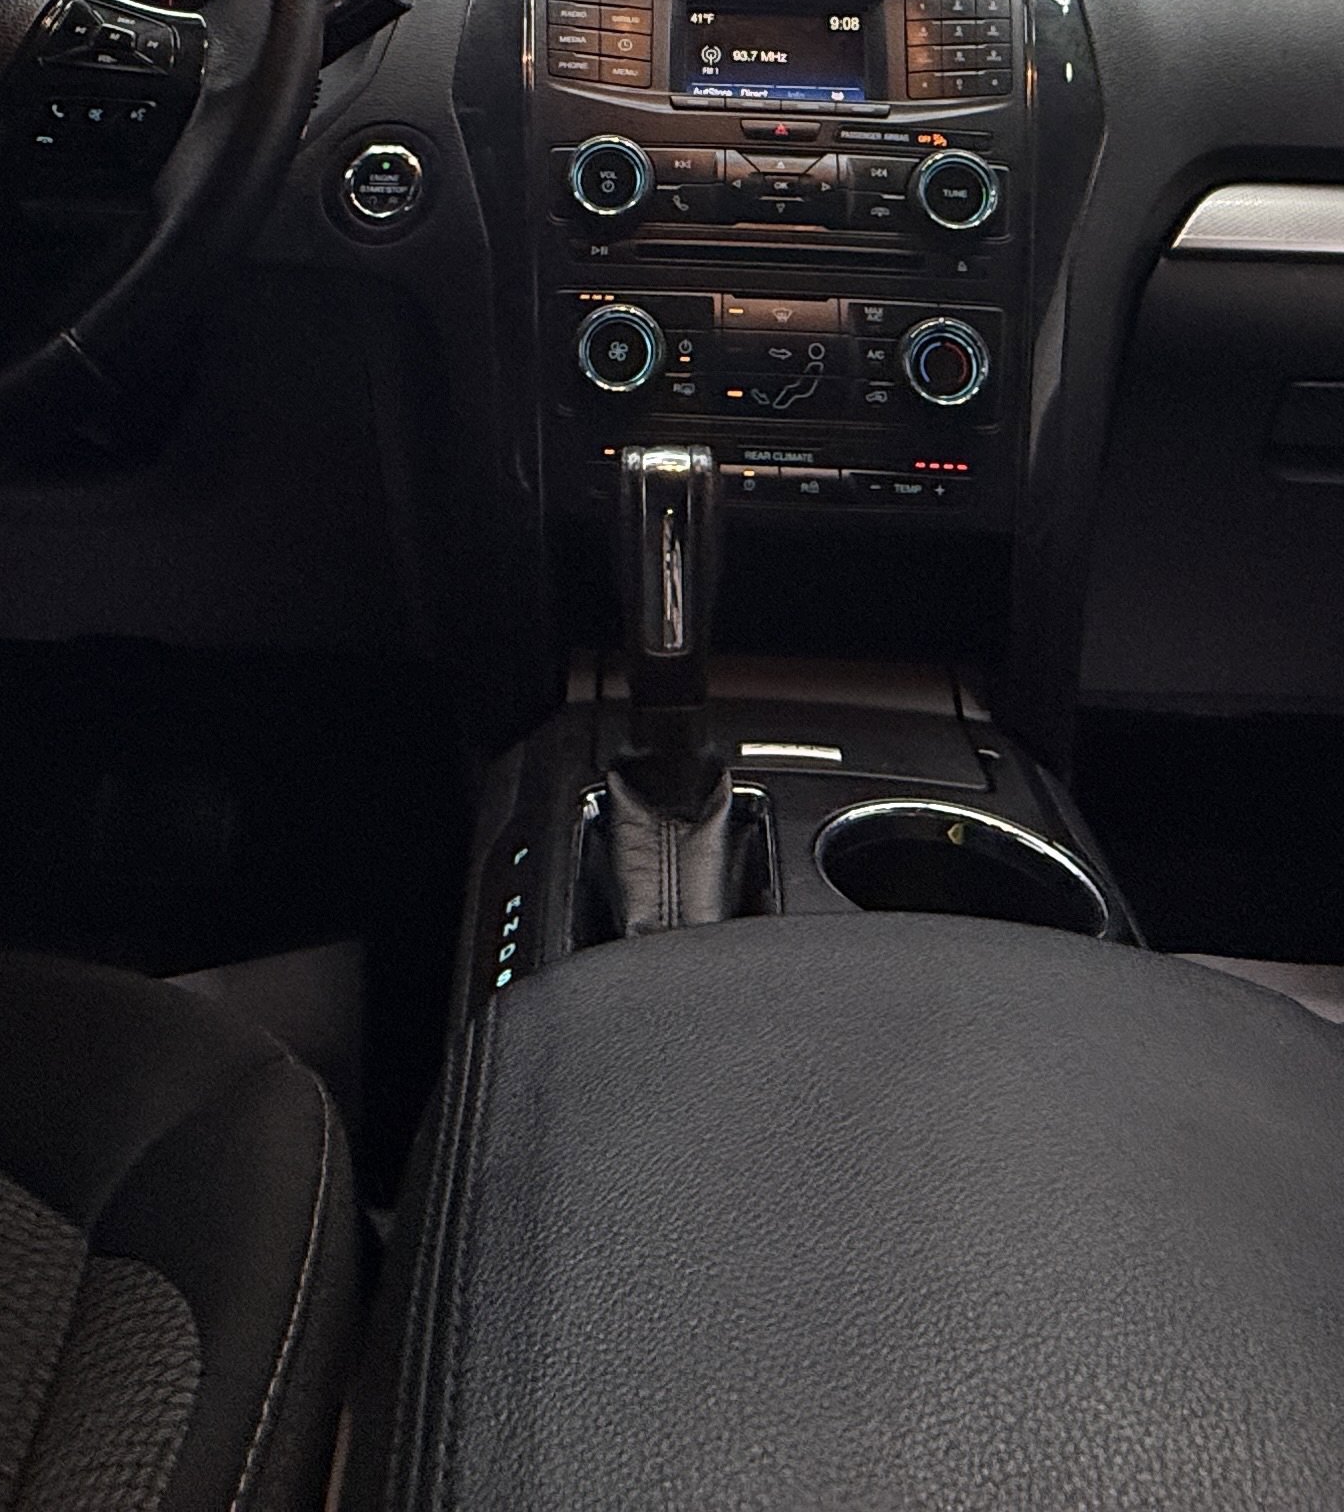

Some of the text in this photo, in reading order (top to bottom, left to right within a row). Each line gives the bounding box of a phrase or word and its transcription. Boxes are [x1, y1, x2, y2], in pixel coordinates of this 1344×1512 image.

[560, 9, 588, 19] RADIO
[829, 15, 861, 32] 9:08
[559, 35, 587, 44] MEDIA
[732, 49, 789, 64] 93.7 MHz
[558, 61, 590, 70] PHONE
[612, 68, 639, 77] MENU
[368, 173, 401, 182] ENGINE
[599, 170, 618, 180] VOL
[772, 181, 789, 190] OK
[941, 188, 968, 199] TUNE
[866, 348, 886, 360] A/C
[744, 450, 814, 463] REAR CLIMATE
[893, 482, 923, 494] TEMP
[503, 916, 519, 937] N
[499, 942, 516, 963] D
[496, 969, 512, 987] S
